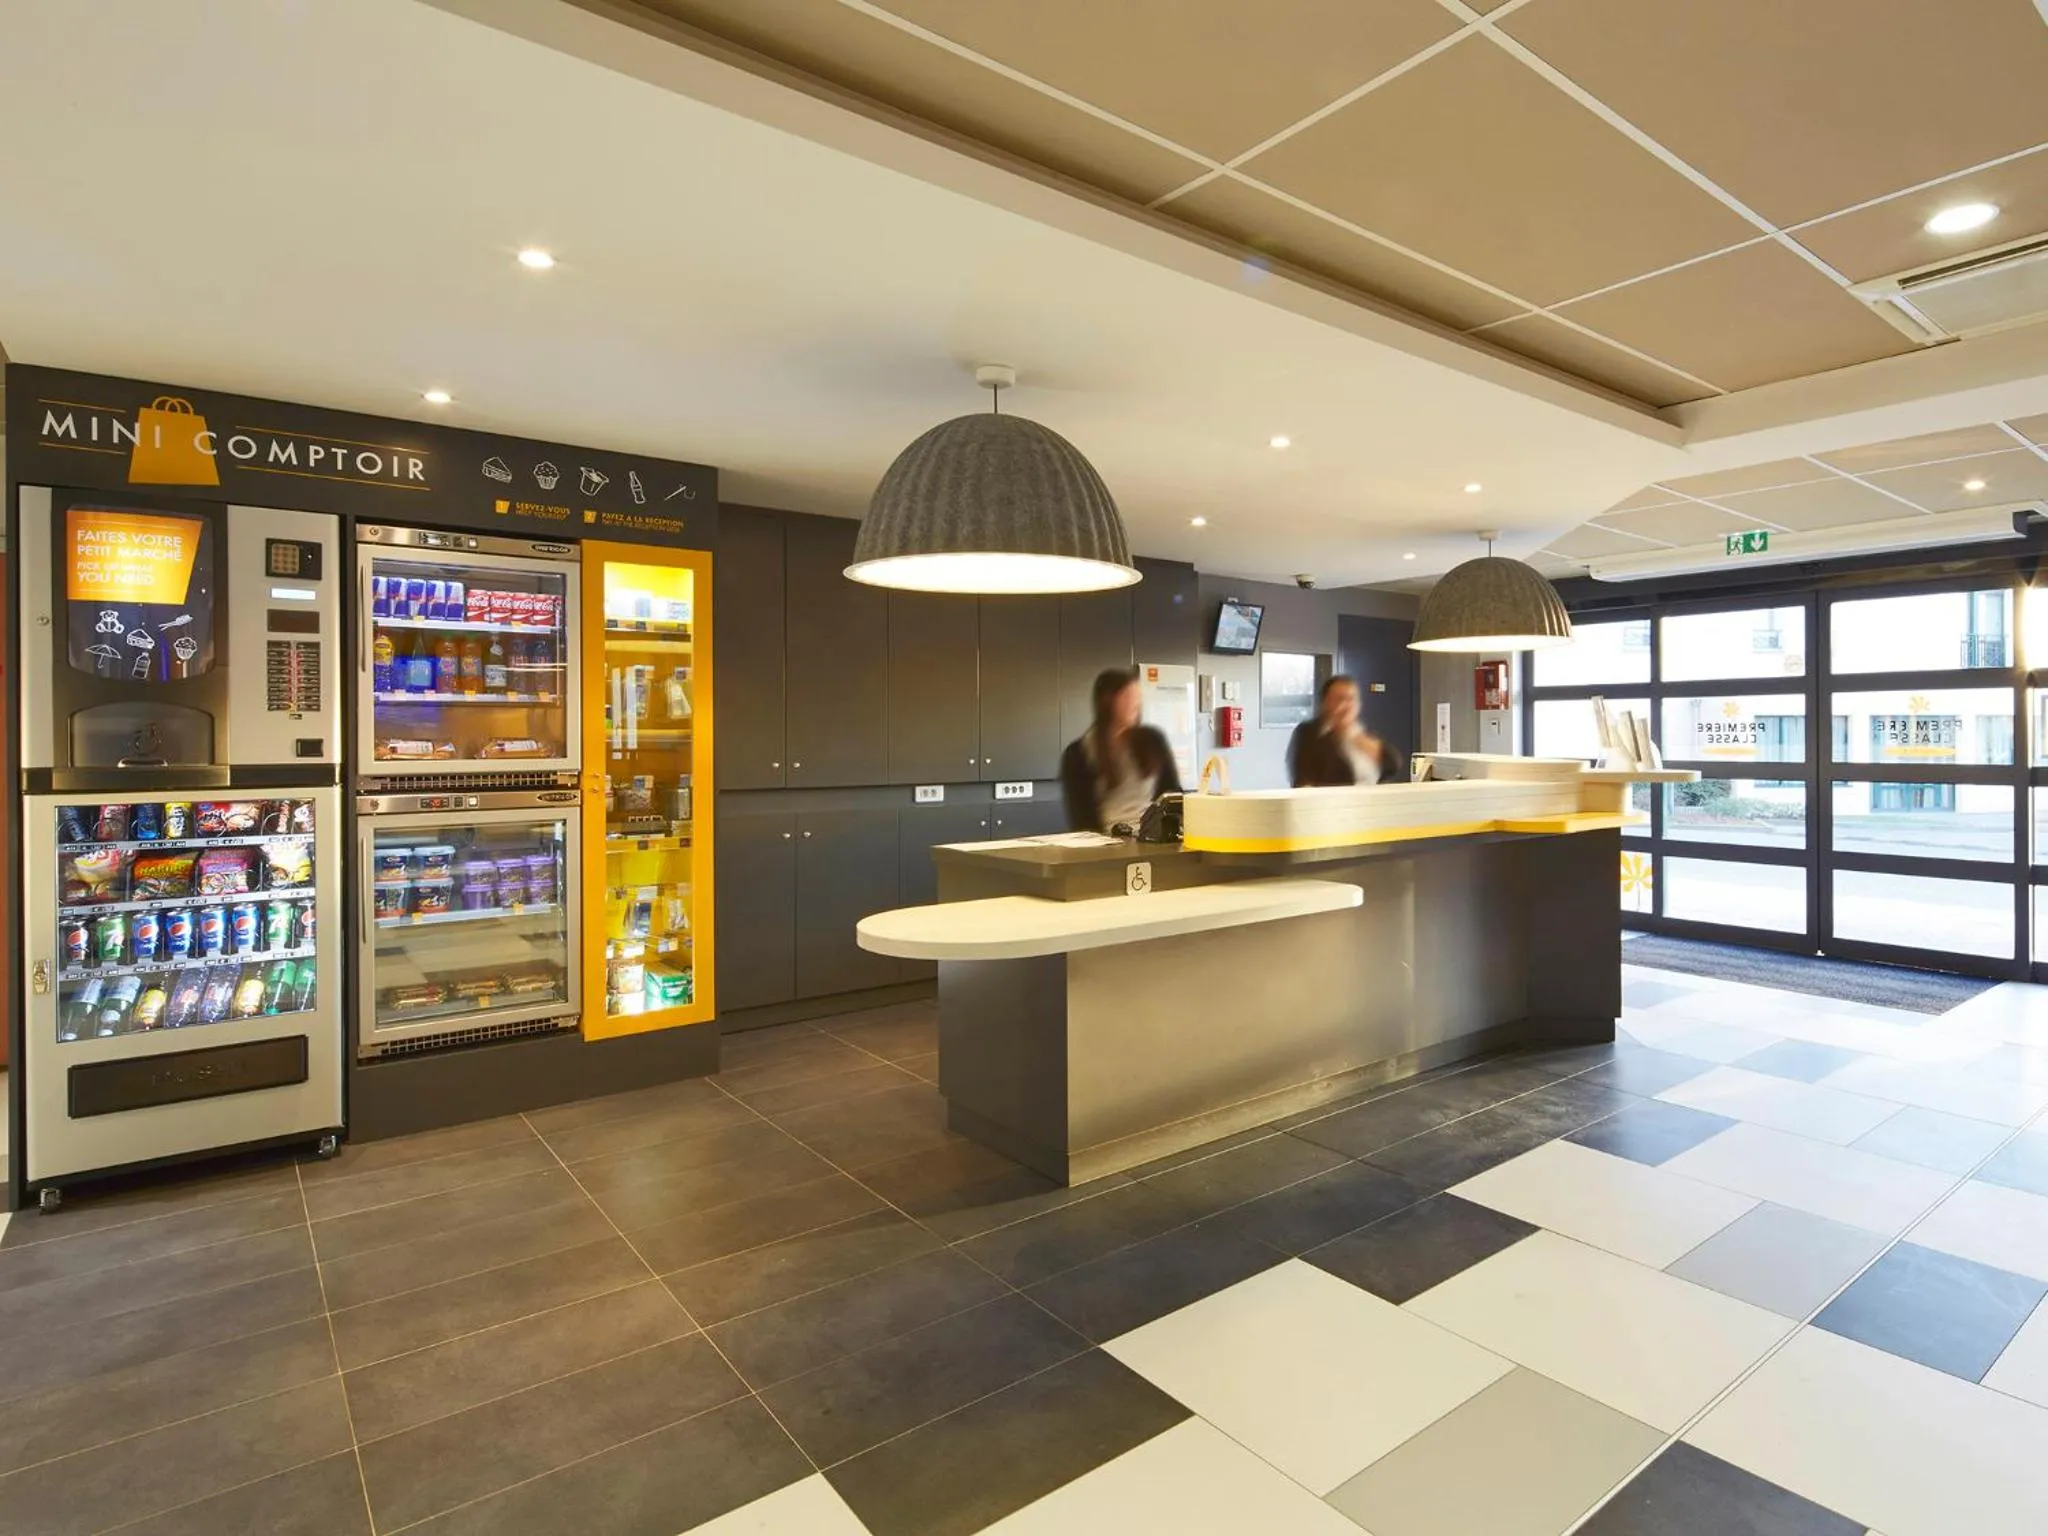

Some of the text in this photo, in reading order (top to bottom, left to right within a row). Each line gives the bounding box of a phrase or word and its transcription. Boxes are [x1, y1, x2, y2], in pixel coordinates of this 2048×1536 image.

[41, 409, 426, 481] MINI COMPTOIR
[77, 530, 183, 547] FAITES VOTRE
[77, 545, 111, 556] PETIT
[77, 572, 110, 583] YOU
